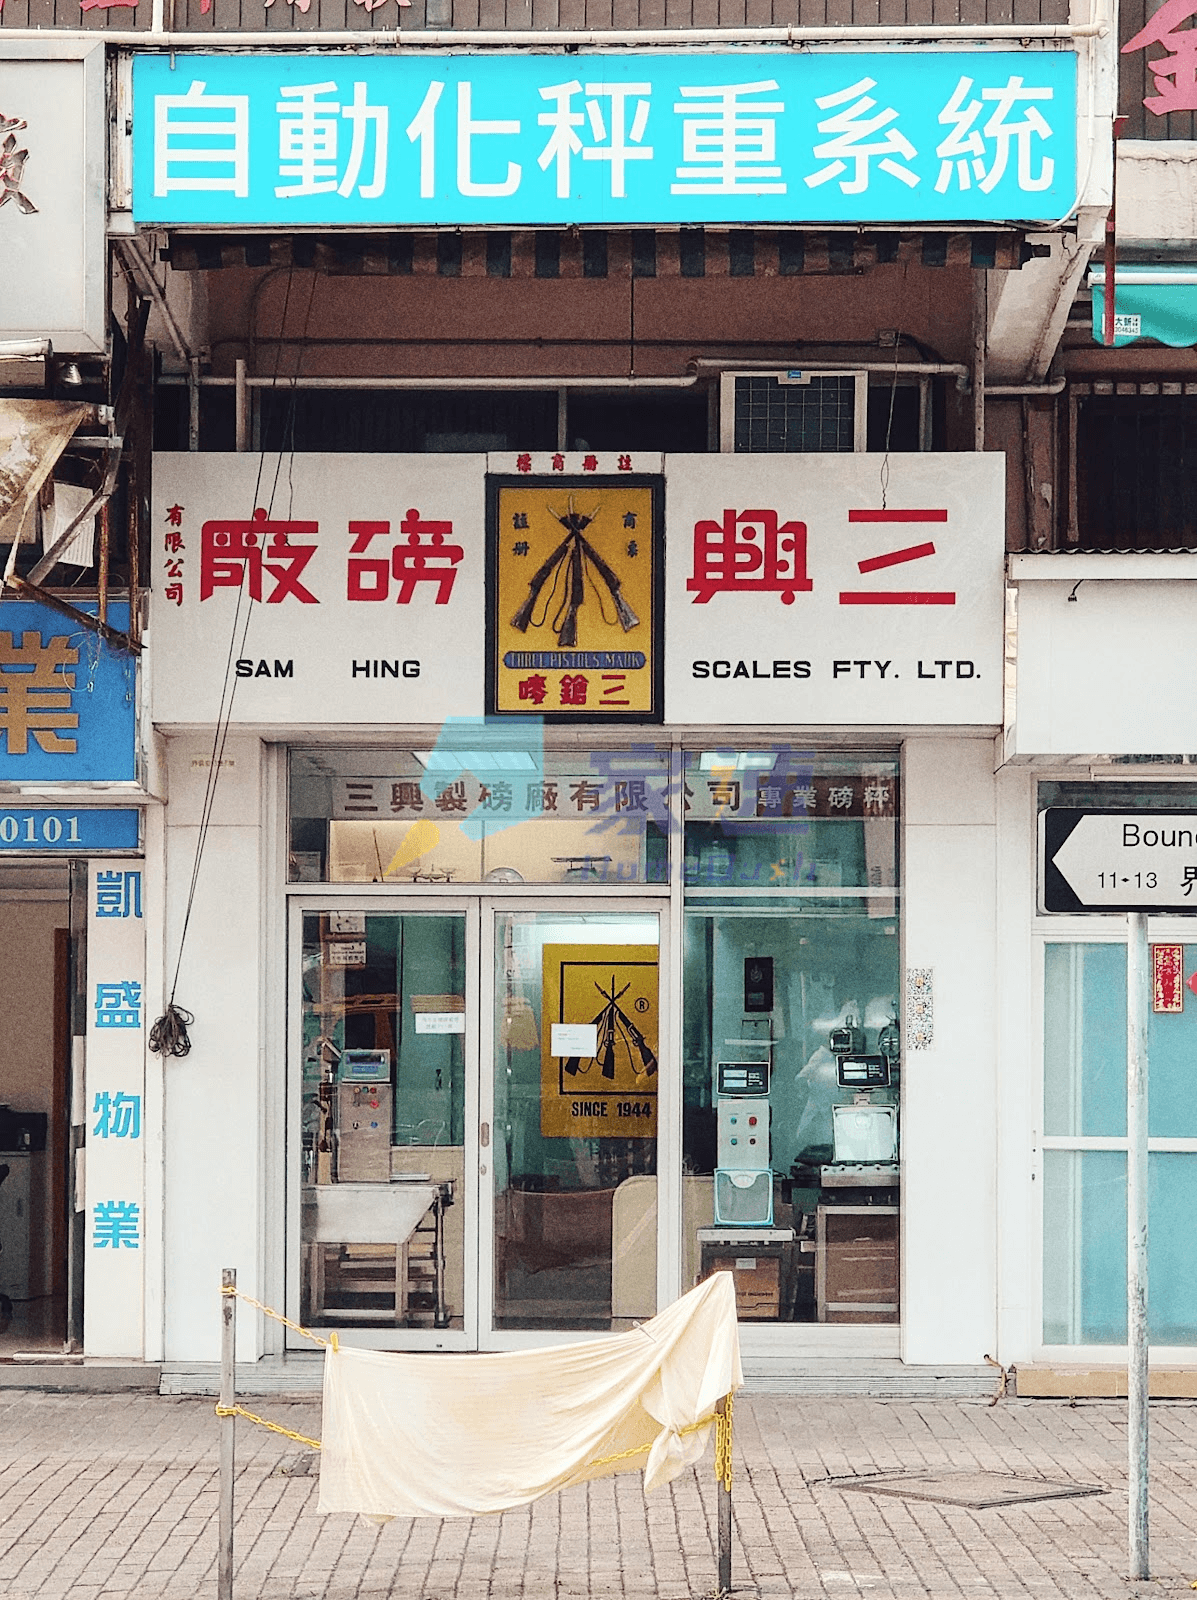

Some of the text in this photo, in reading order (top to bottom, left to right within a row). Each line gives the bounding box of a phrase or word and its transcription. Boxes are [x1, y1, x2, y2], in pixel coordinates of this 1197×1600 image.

[154, 76, 1054, 199] 自動化秤重系統
[164, 503, 186, 607] 有限公司
[235, 659, 420, 678] SAM HING
[692, 660, 981, 679] SCALES FTY. LTD.
[1122, 823, 1197, 847] Boun
[571, 1101, 652, 1117] SINCE 1944
